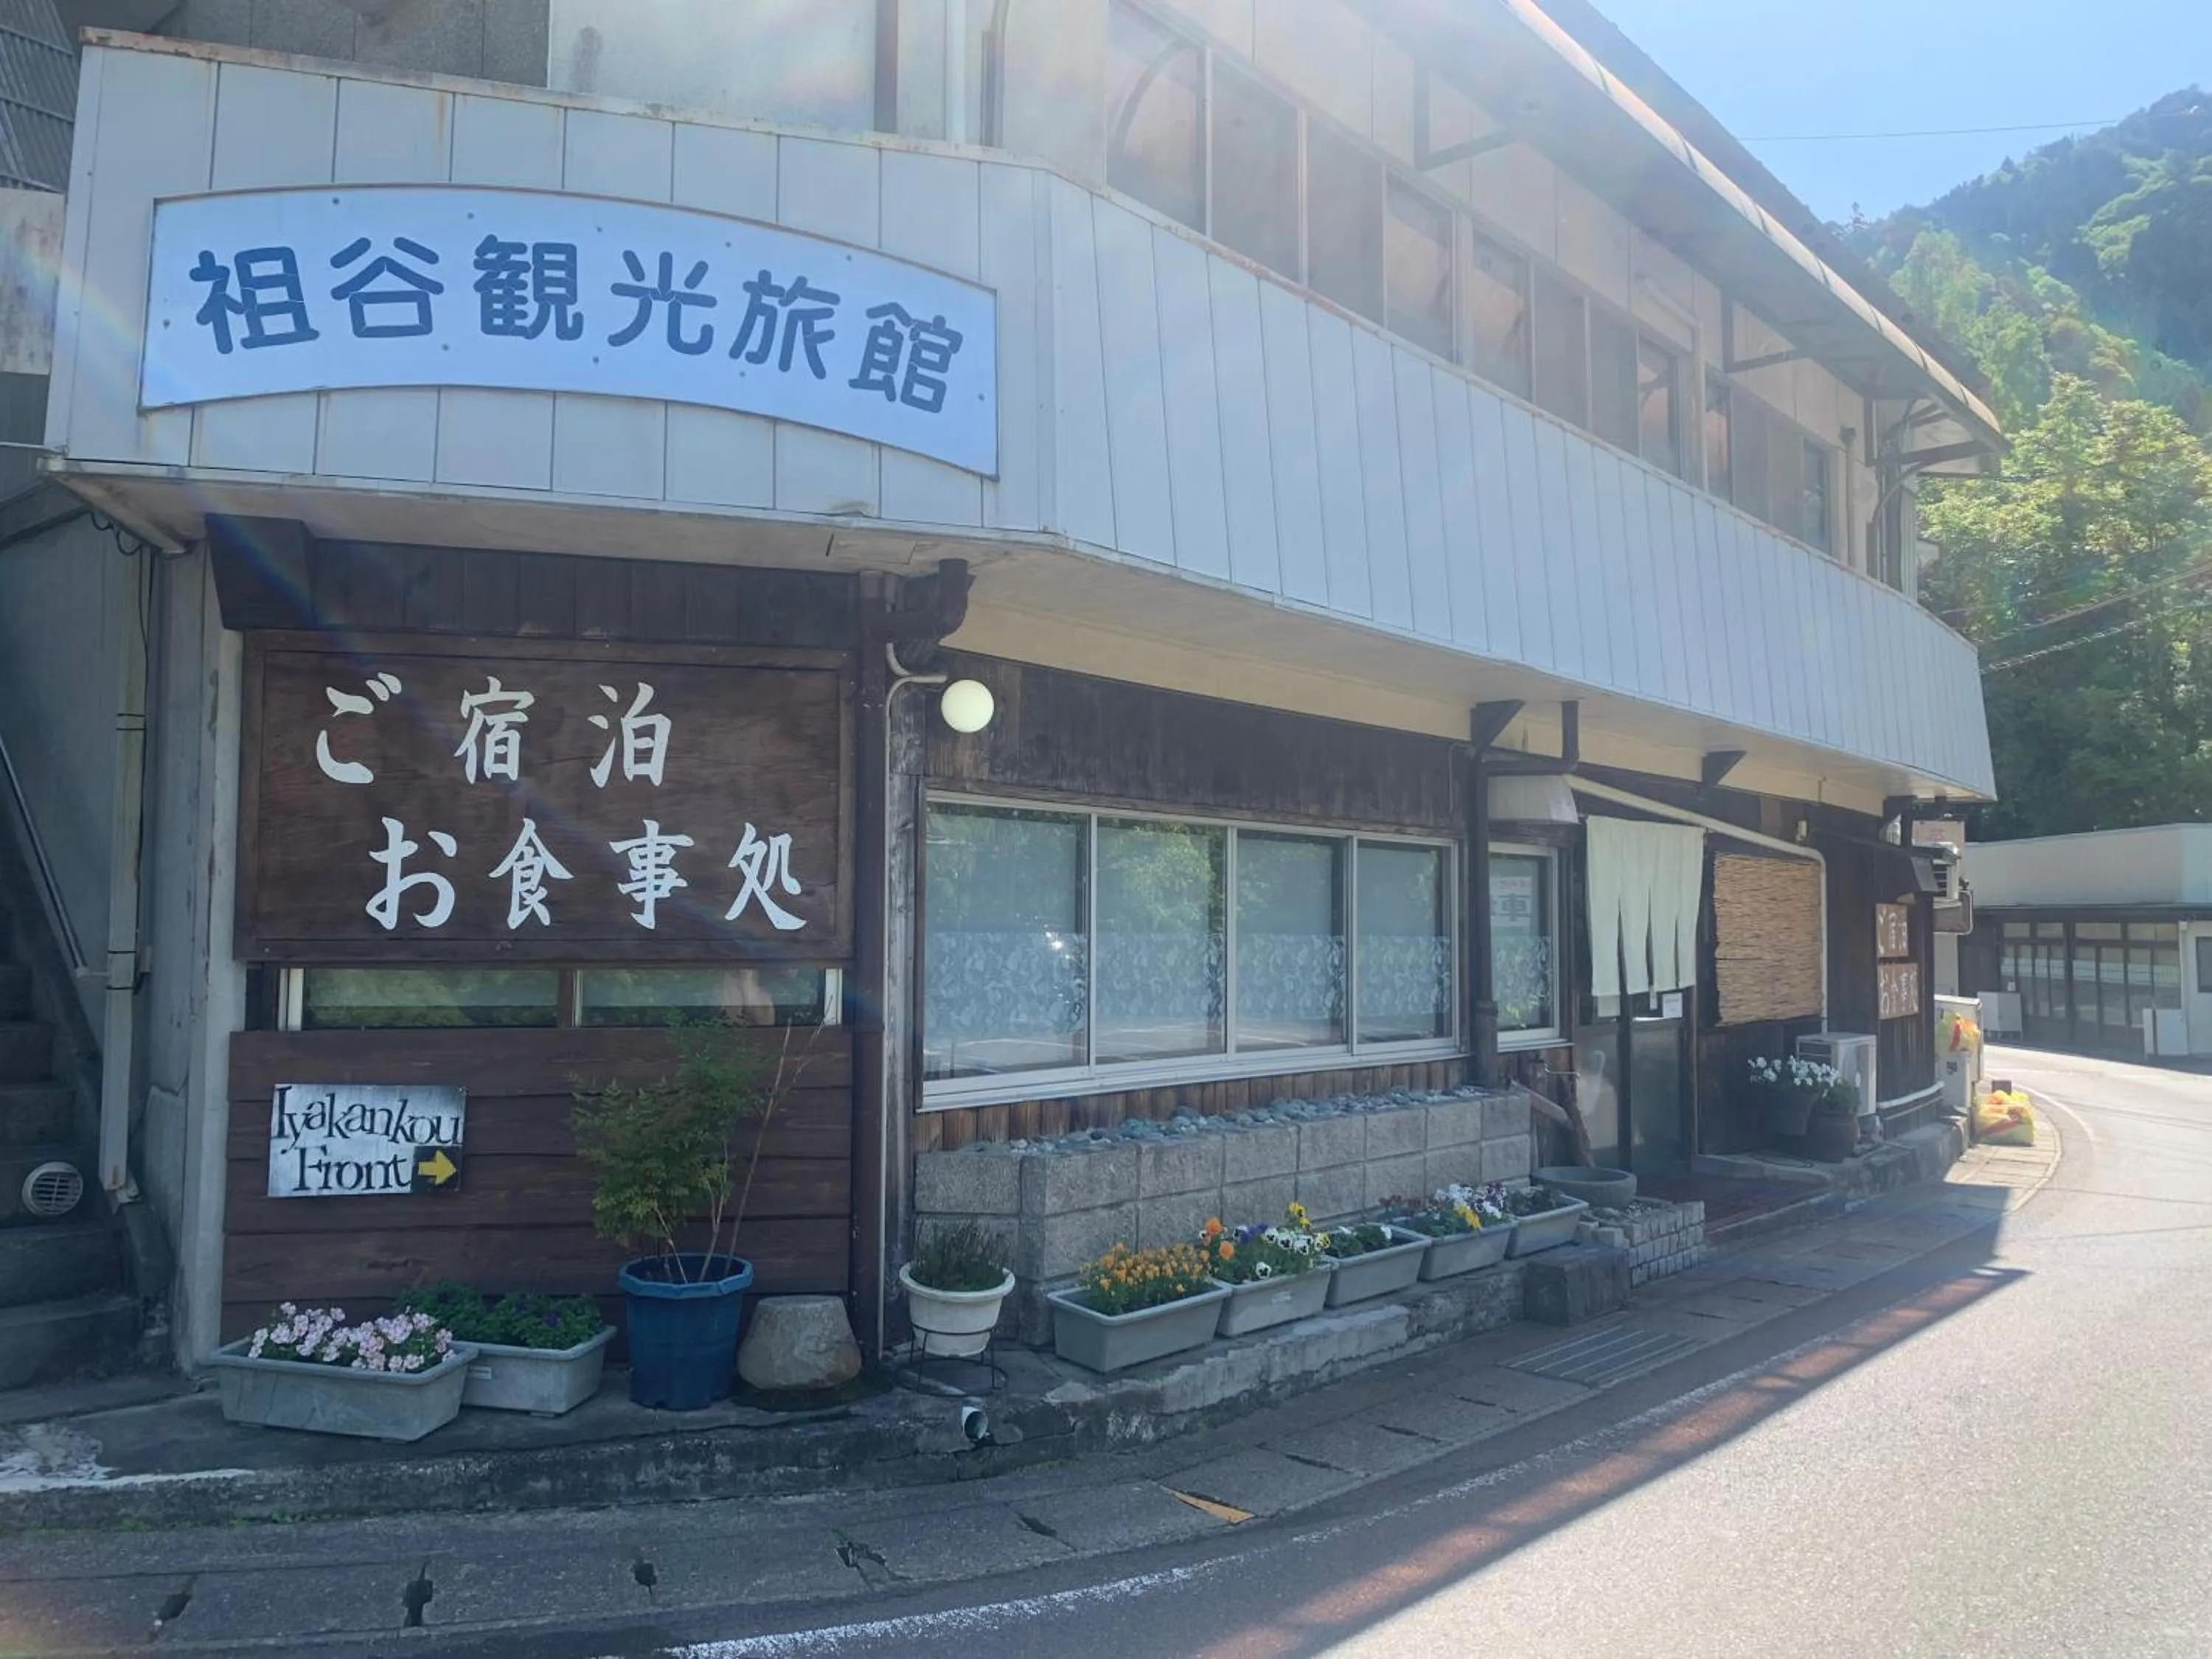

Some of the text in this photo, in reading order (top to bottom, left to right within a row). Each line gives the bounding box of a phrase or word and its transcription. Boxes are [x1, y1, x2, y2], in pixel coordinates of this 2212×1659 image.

[189, 234, 963, 414] 祖谷観光旅館
[316, 672, 672, 788] ご宿泊
[365, 816, 807, 931] お食事処
[273, 1085, 463, 1154] Iyakankou
[293, 1144, 411, 1191] Front
